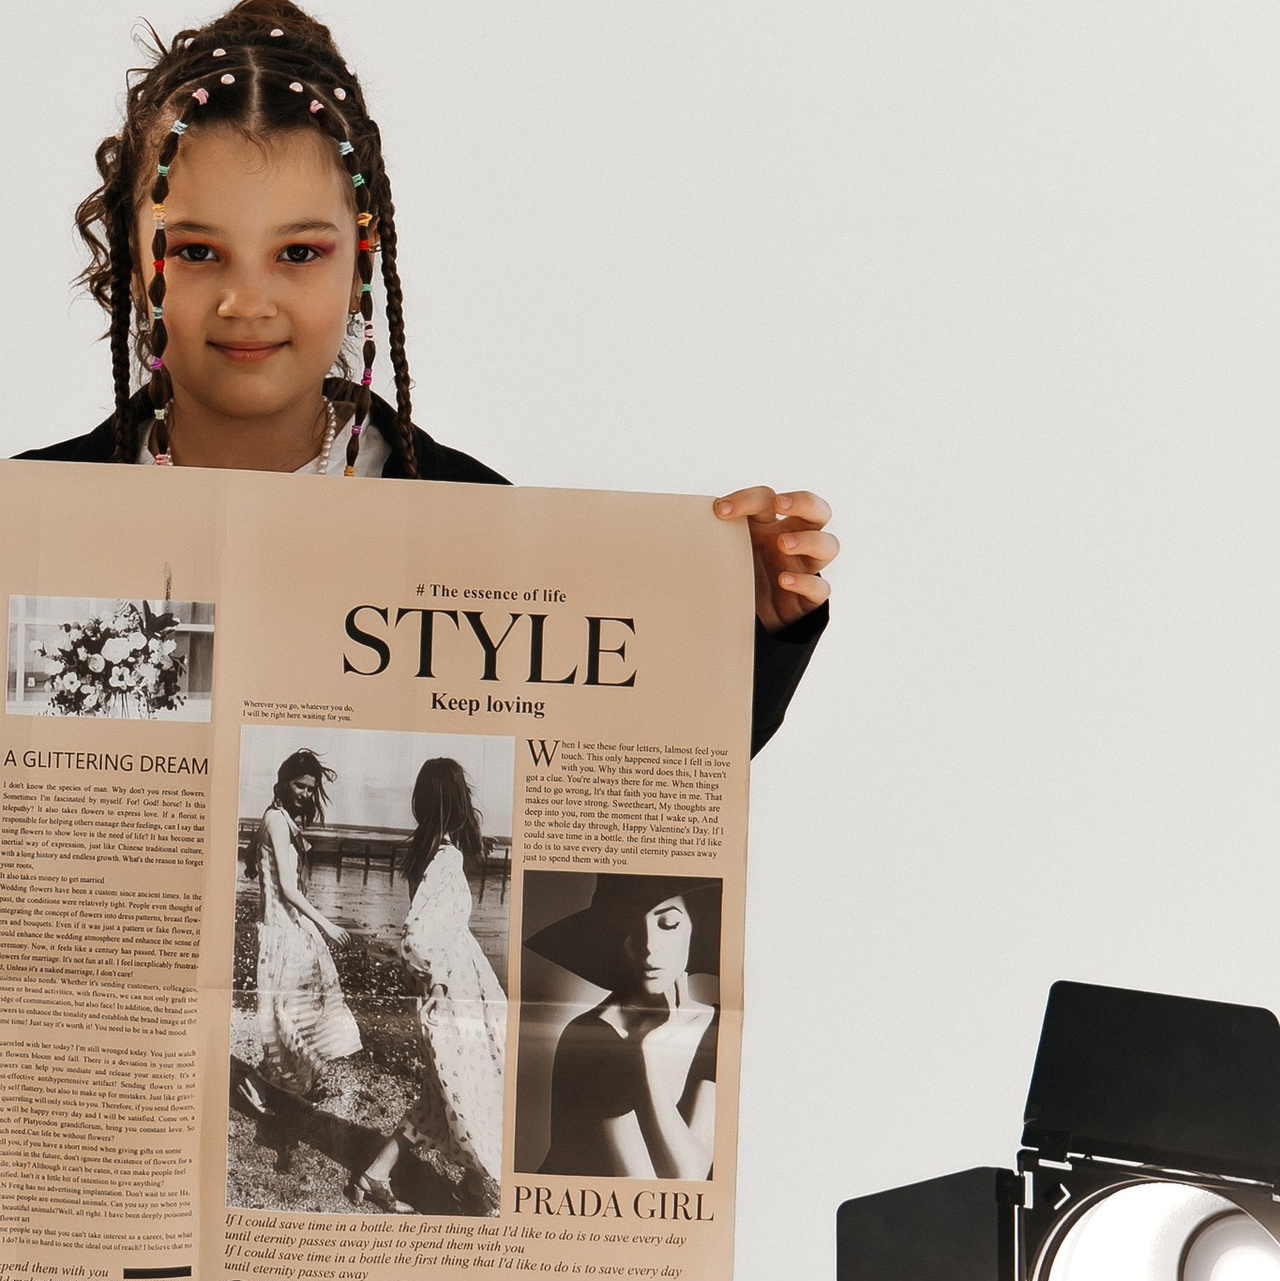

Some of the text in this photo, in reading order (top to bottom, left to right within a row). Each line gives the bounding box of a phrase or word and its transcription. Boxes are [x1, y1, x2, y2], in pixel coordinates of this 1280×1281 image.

[416, 584, 566, 602] # The essence of life
[343, 604, 638, 688] STYLE
[431, 692, 545, 719] Keep loving
[4, 750, 208, 775] A GLITTERING DREAM
[513, 1186, 715, 1222] PRADA GIRL
[225, 1213, 237, 1227] If
[237, 1215, 243, 1226] I
[245, 1217, 278, 1228] could
[279, 1221, 305, 1230] save
[308, 1220, 333, 1231] time
[335, 1221, 346, 1232] in
[360, 1221, 394, 1232] bottle.
[398, 1221, 416, 1233] the
[416, 1222, 442, 1236] first
[445, 1222, 474, 1237] thing
[477, 1224, 500, 1236] that
[503, 1226, 518, 1237] I'd
[521, 1227, 542, 1239] like
[545, 1231, 556, 1240] to
[559, 1229, 573, 1240] do
[577, 1231, 586, 1241] is
[589, 1233, 600, 1241] to
[603, 1235, 629, 1243] save
[632, 1236, 663, 1246] every
[665, 1233, 687, 1247] day
[31, 1262, 58, 1274] them
[62, 1265, 85, 1276] with
[87, 1269, 109, 1280] you
